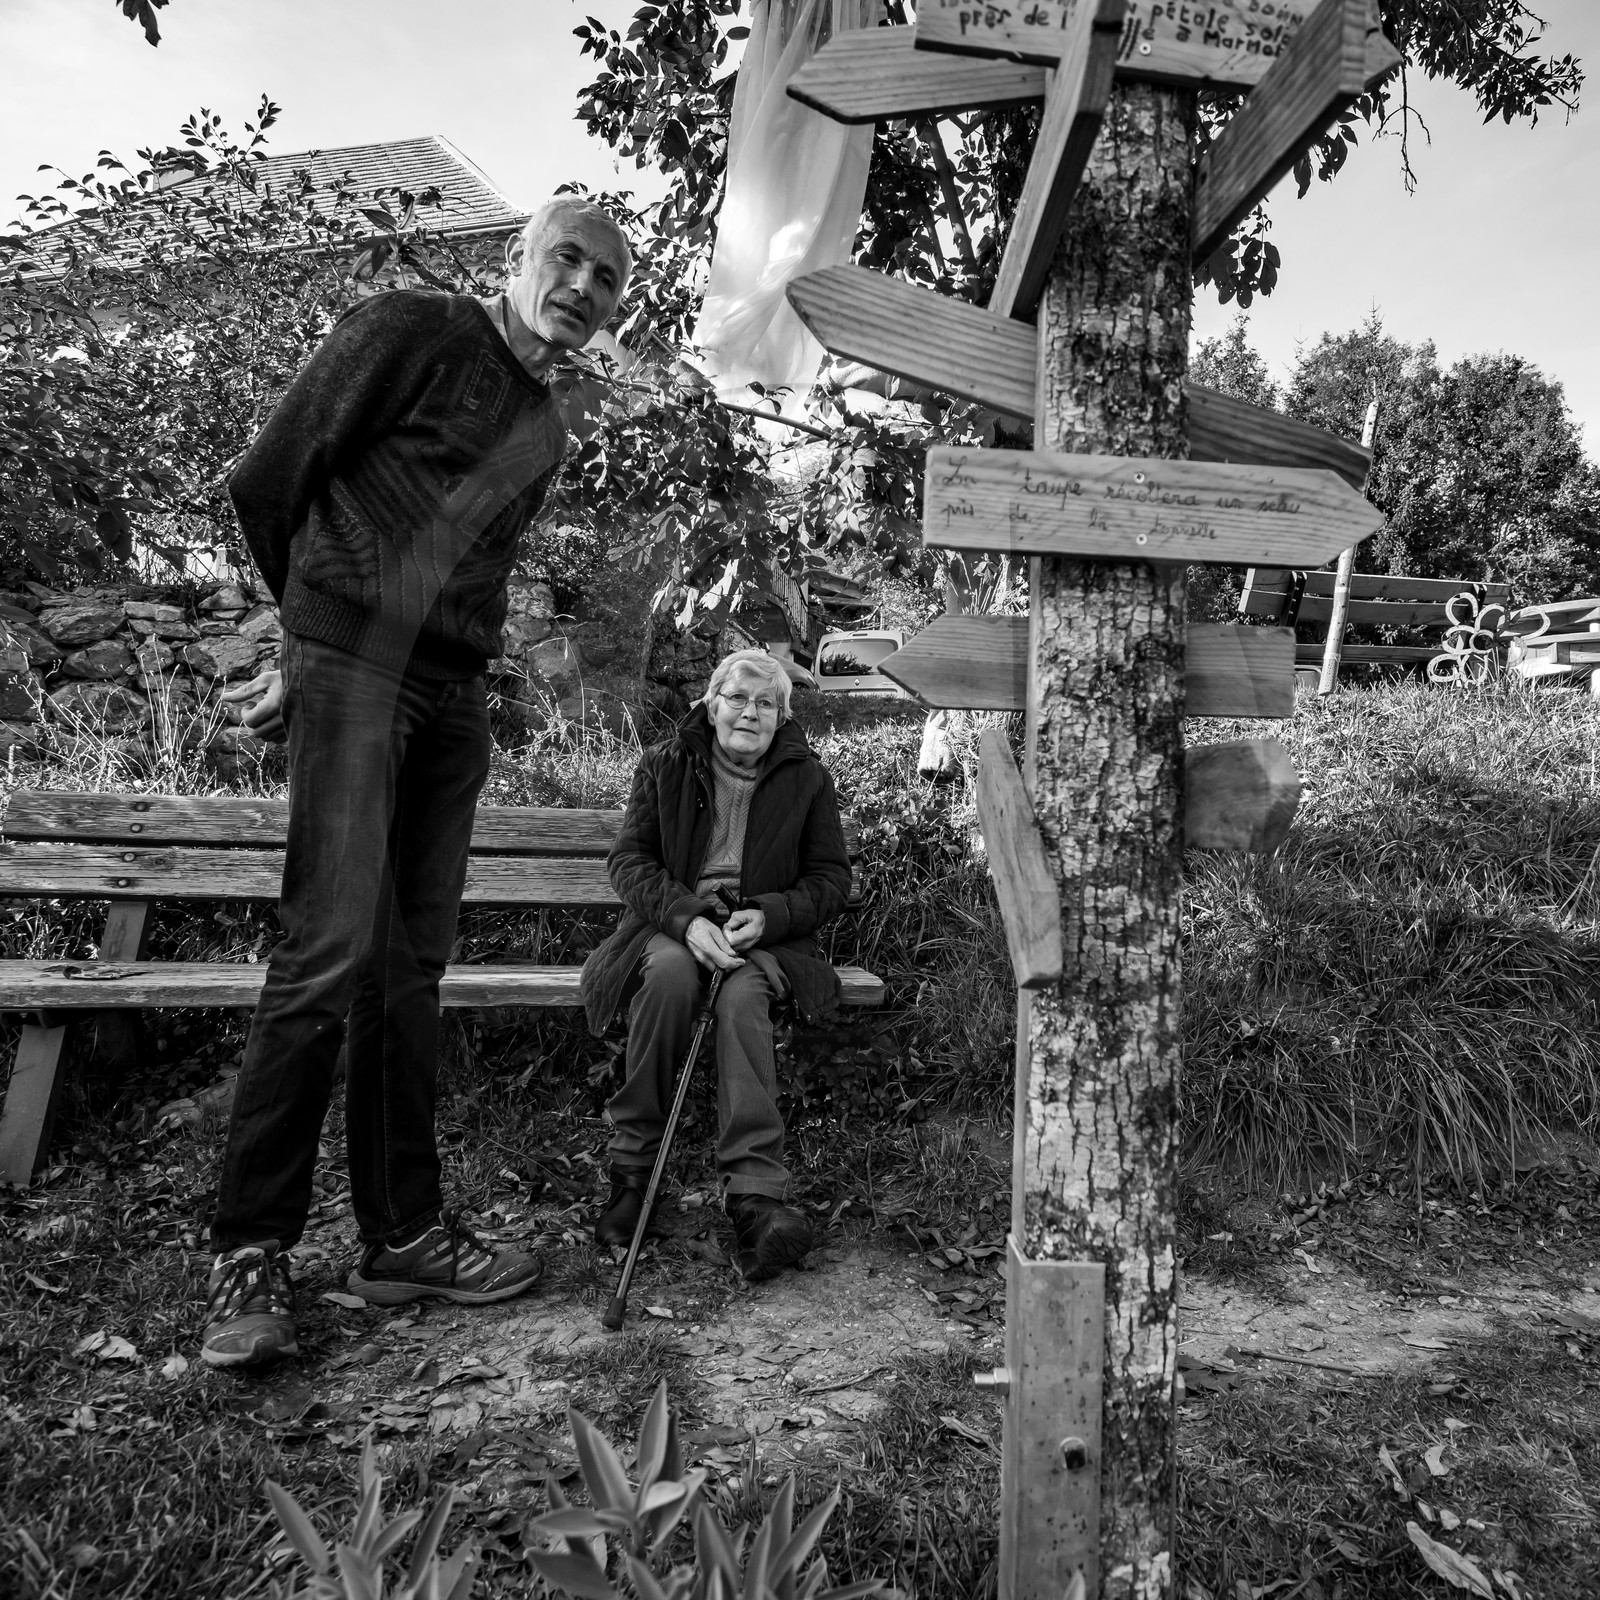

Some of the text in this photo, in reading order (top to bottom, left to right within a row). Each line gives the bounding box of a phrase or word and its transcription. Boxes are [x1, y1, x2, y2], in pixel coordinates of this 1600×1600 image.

[960, 4, 1012, 36] près
[1024, 4, 1049, 26] de
[1150, 1, 1231, 34] pétale
[1019, 467, 1083, 511] taupe
[1214, 496, 1245, 511] un
